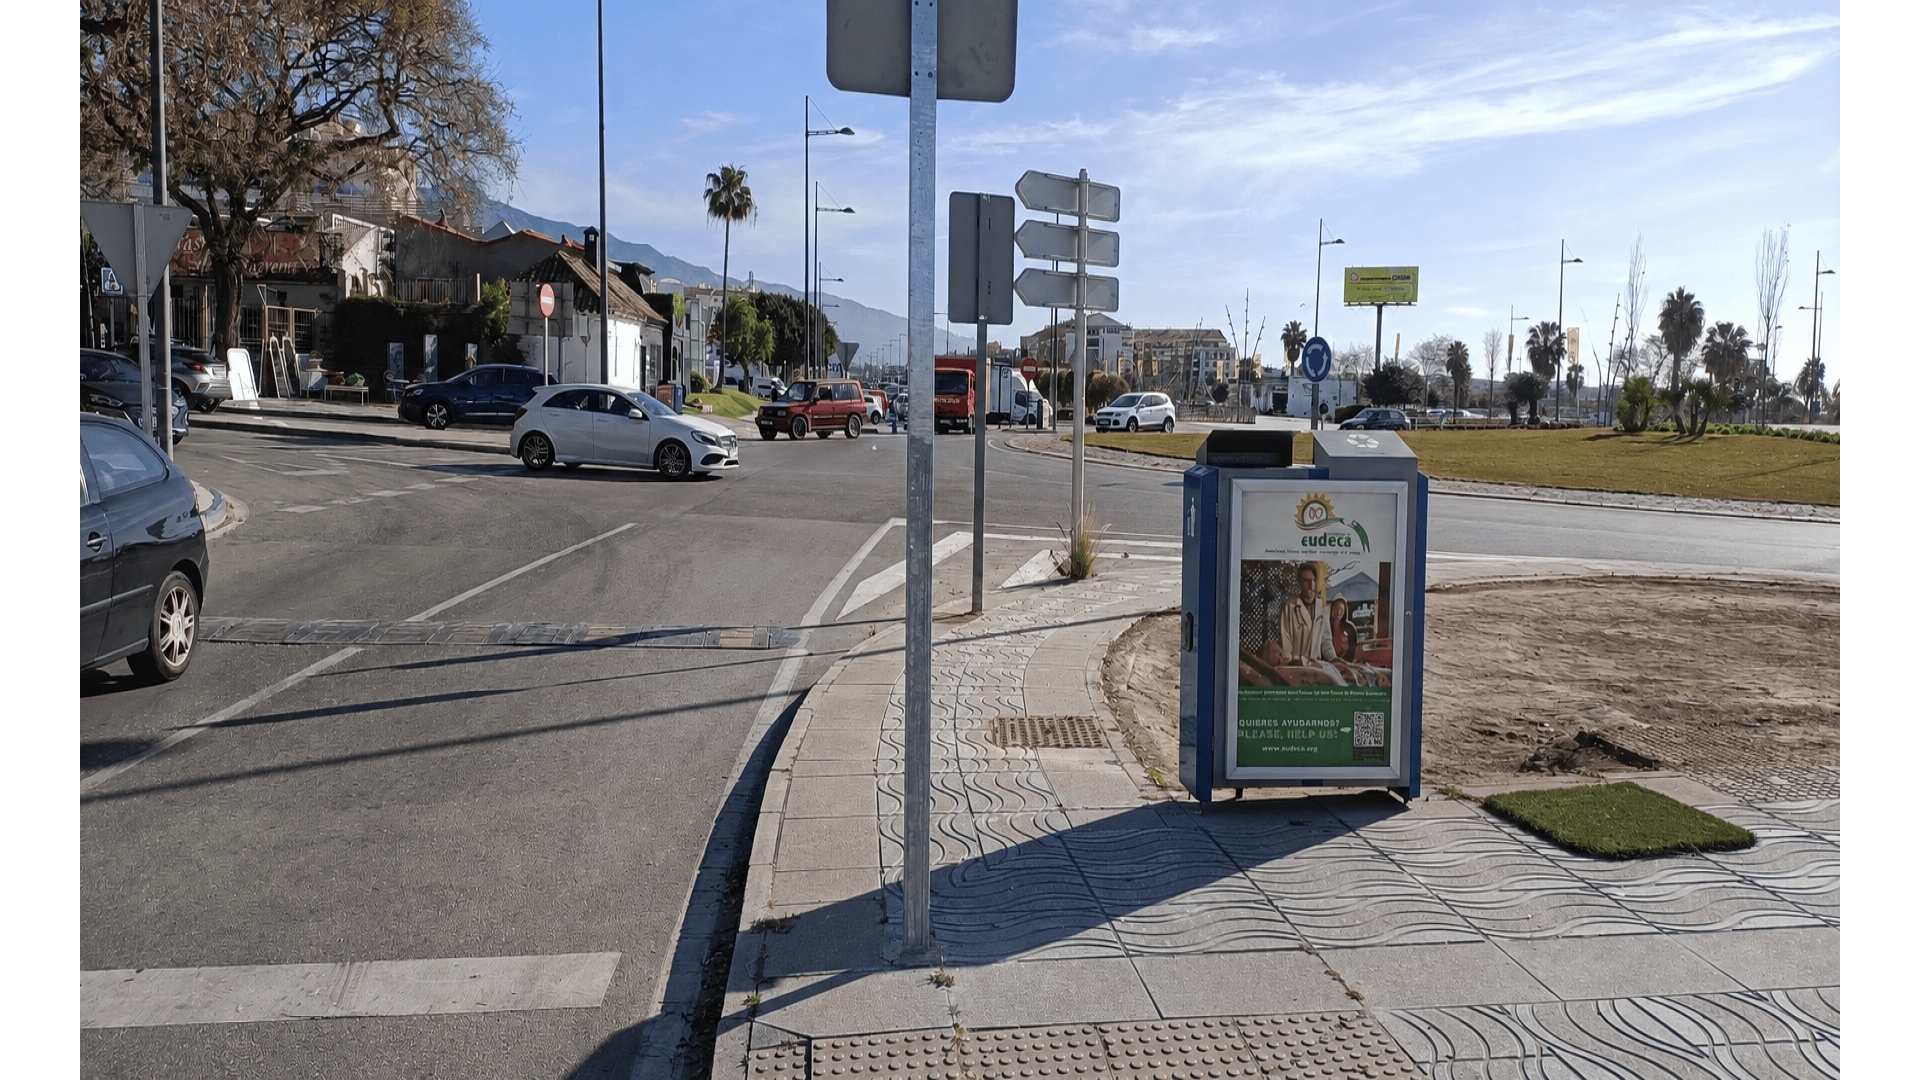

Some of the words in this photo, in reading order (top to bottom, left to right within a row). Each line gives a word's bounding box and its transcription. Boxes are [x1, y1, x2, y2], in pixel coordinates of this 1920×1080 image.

[1301, 532, 1352, 547] eudeca
[1281, 719, 1340, 727] AYUDARNOS?
[1287, 729, 1316, 739] HELP
